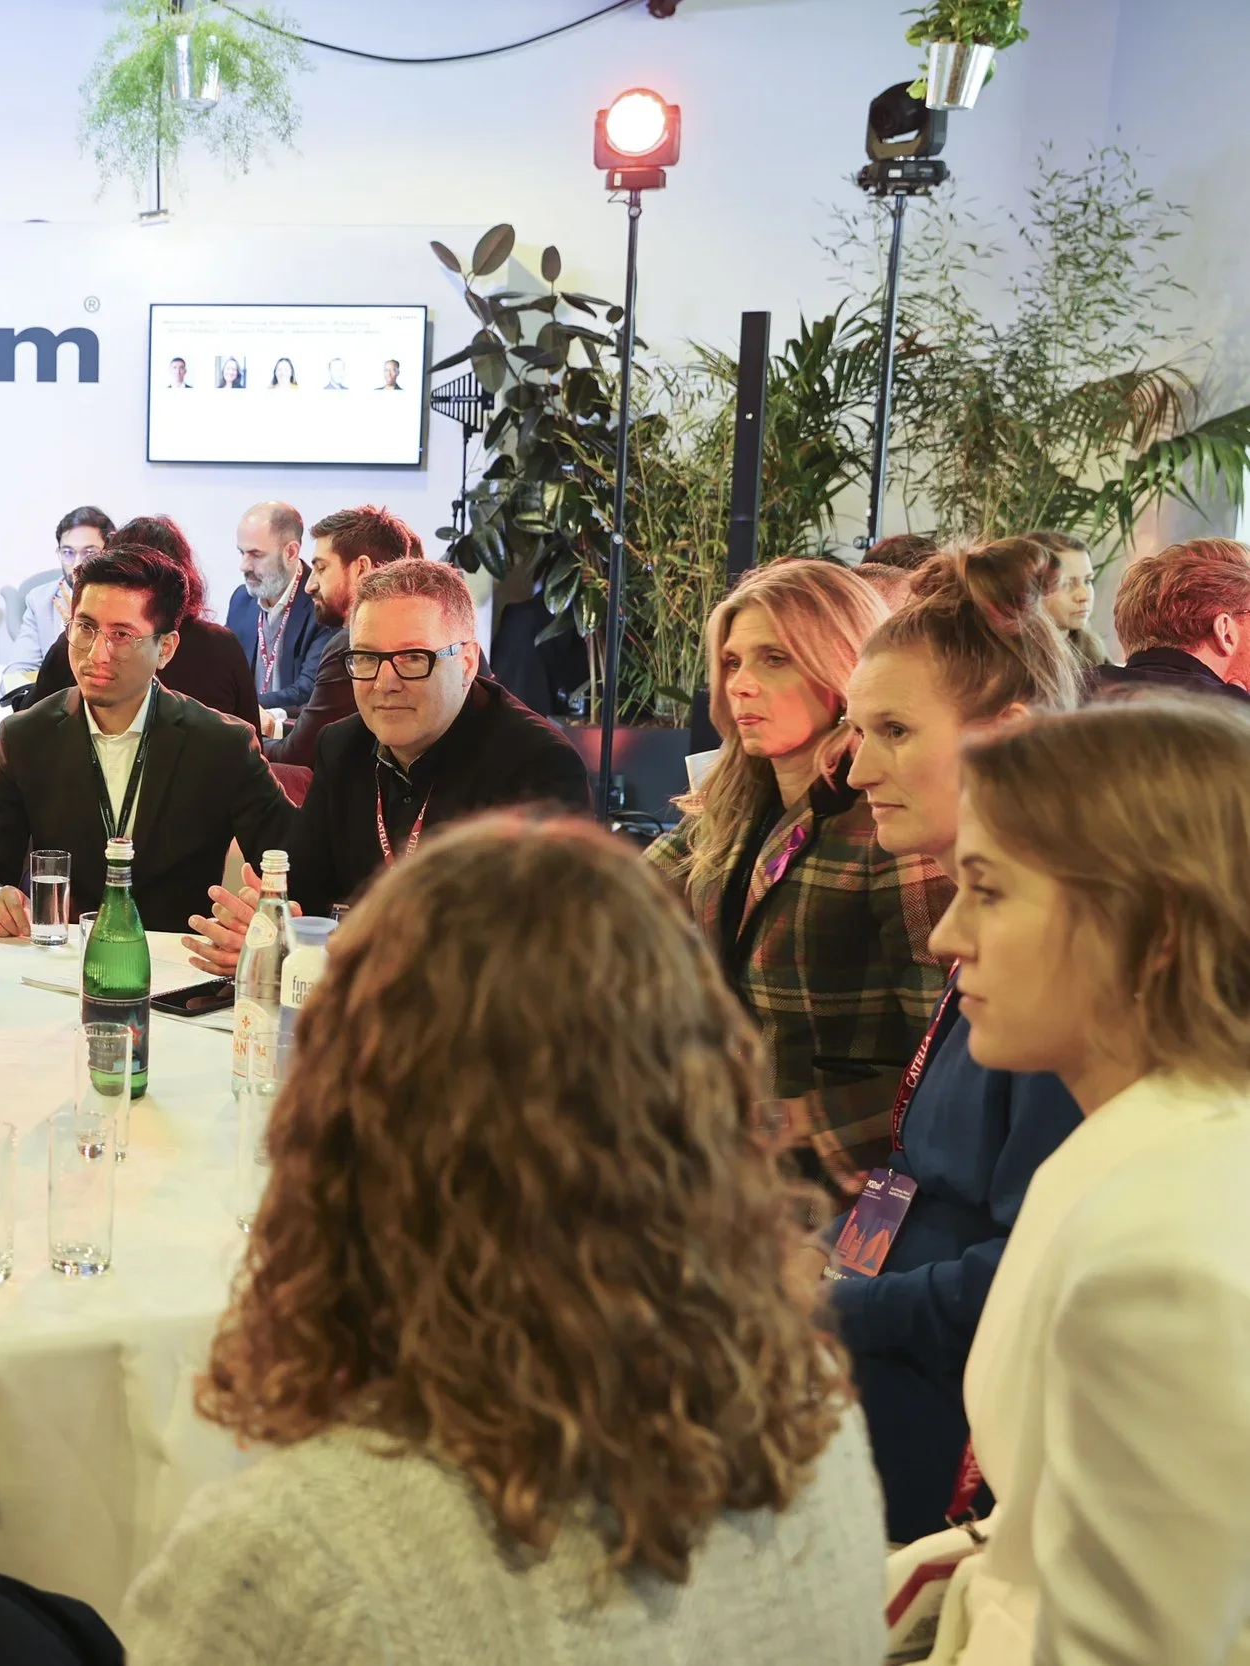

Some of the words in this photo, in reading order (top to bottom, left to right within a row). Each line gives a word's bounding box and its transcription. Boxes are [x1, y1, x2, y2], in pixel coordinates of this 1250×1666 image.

[377, 814, 390, 857] CATELLA
[406, 831, 420, 858] TELLA
[906, 1035, 932, 1088] CATELLA
